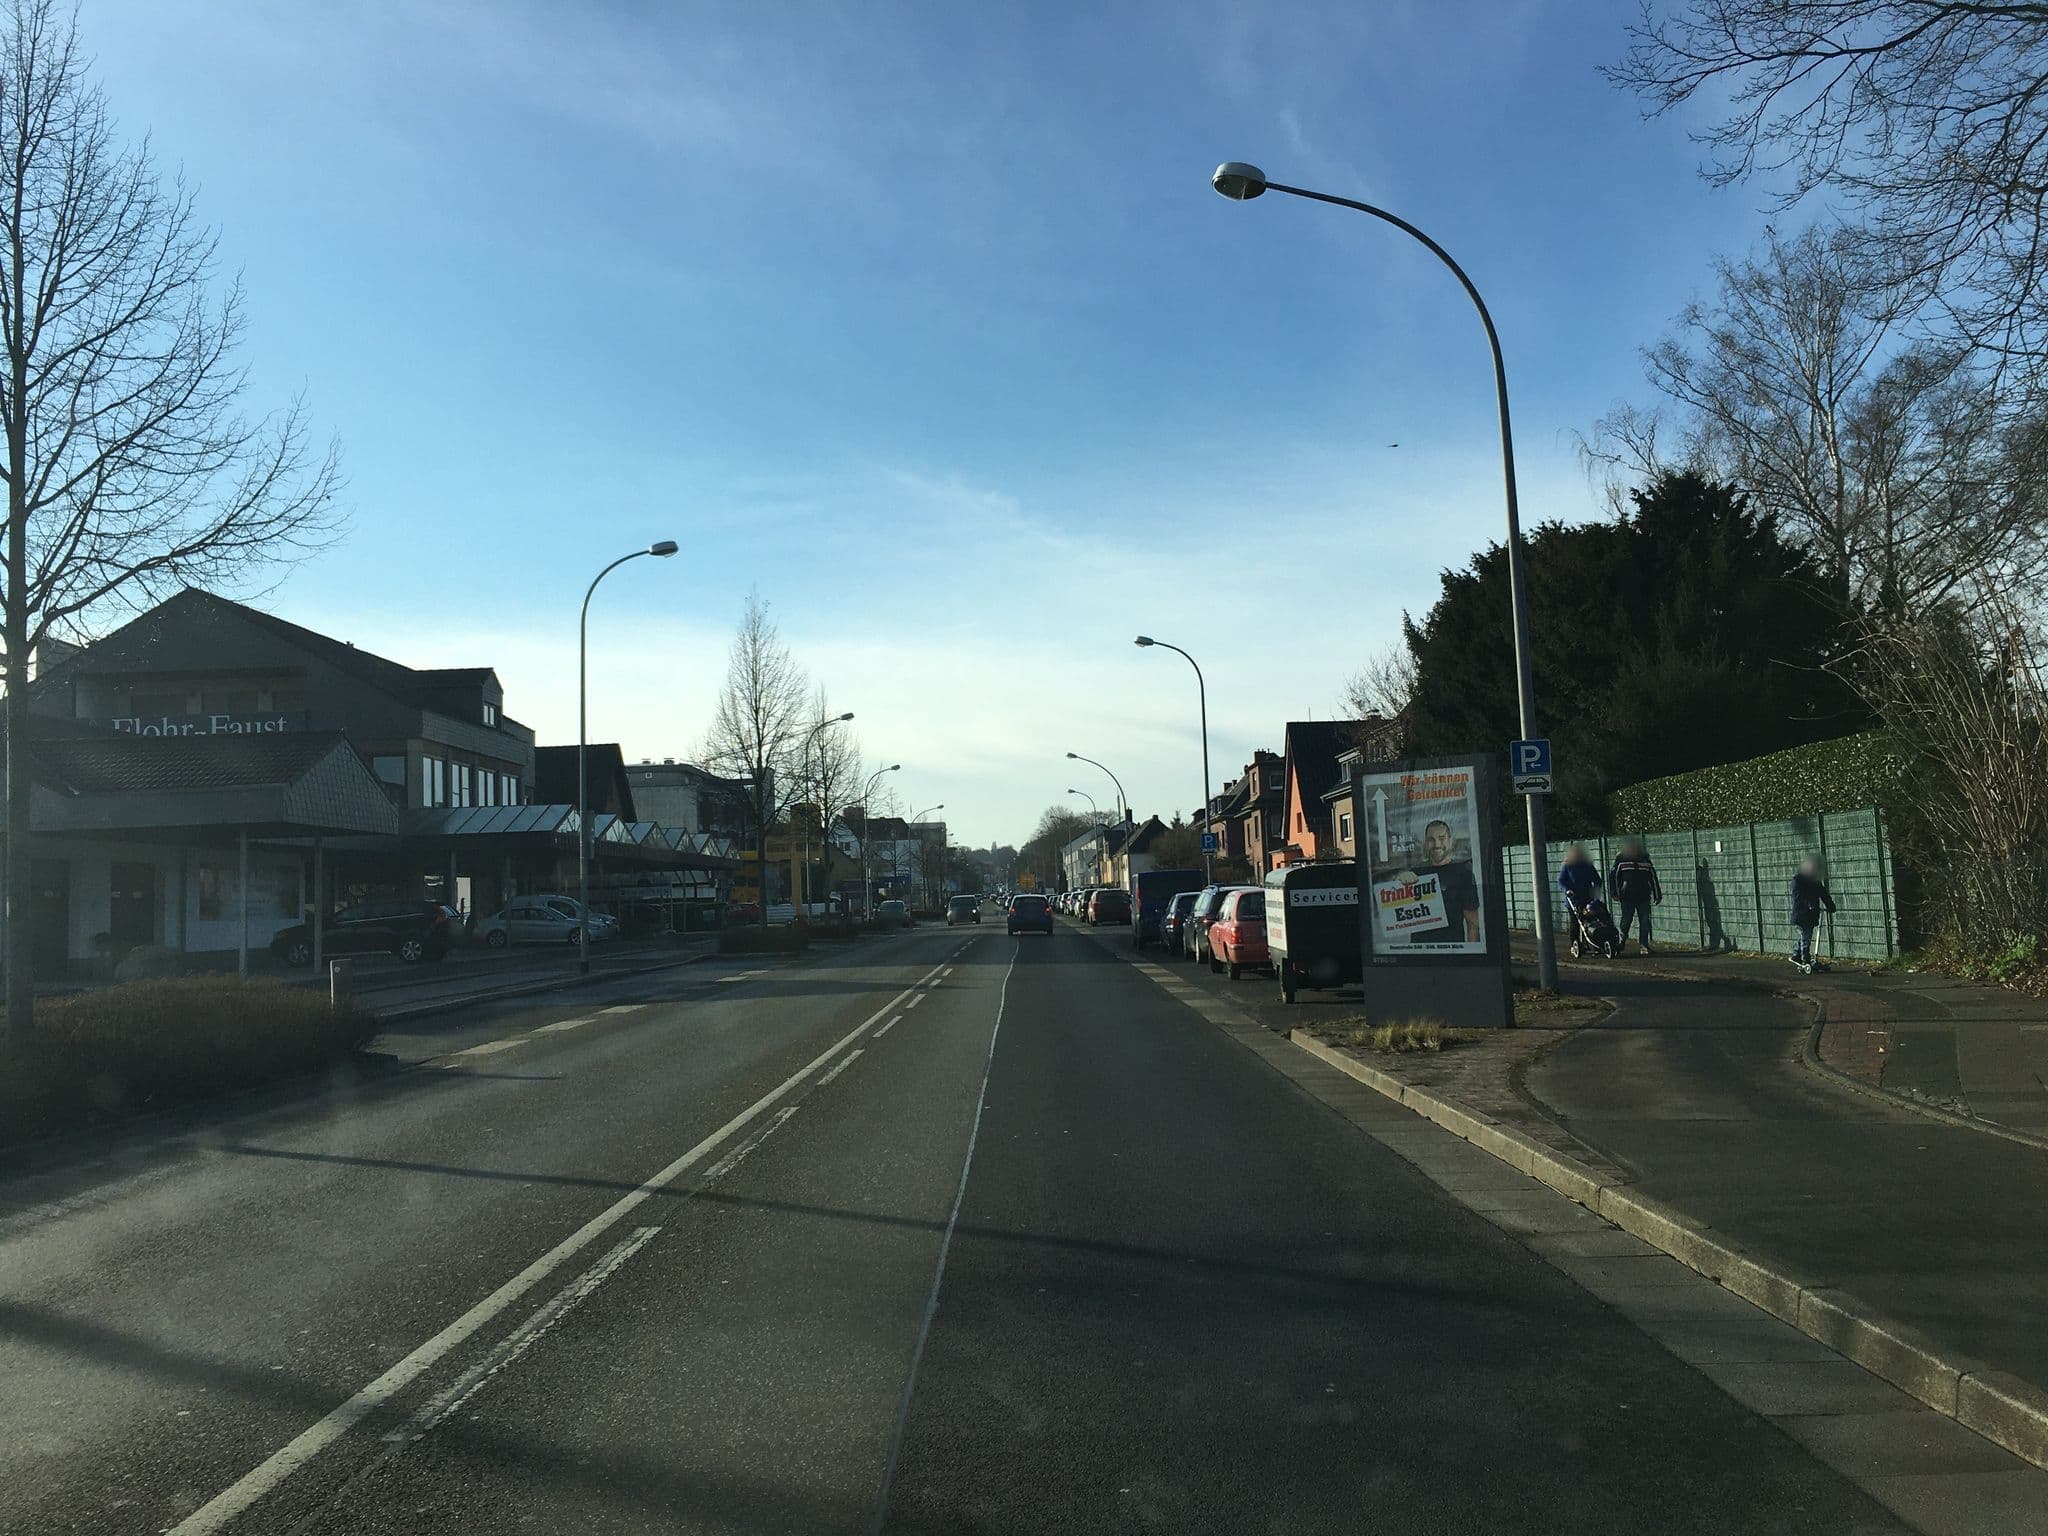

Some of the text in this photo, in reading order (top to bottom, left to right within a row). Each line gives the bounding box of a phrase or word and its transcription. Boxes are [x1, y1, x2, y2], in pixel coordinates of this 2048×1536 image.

[1520, 745, 1541, 773] P
[1204, 835, 1213, 848] P
[1380, 878, 1437, 903] trinkgut
[1394, 903, 1431, 922] Esch
